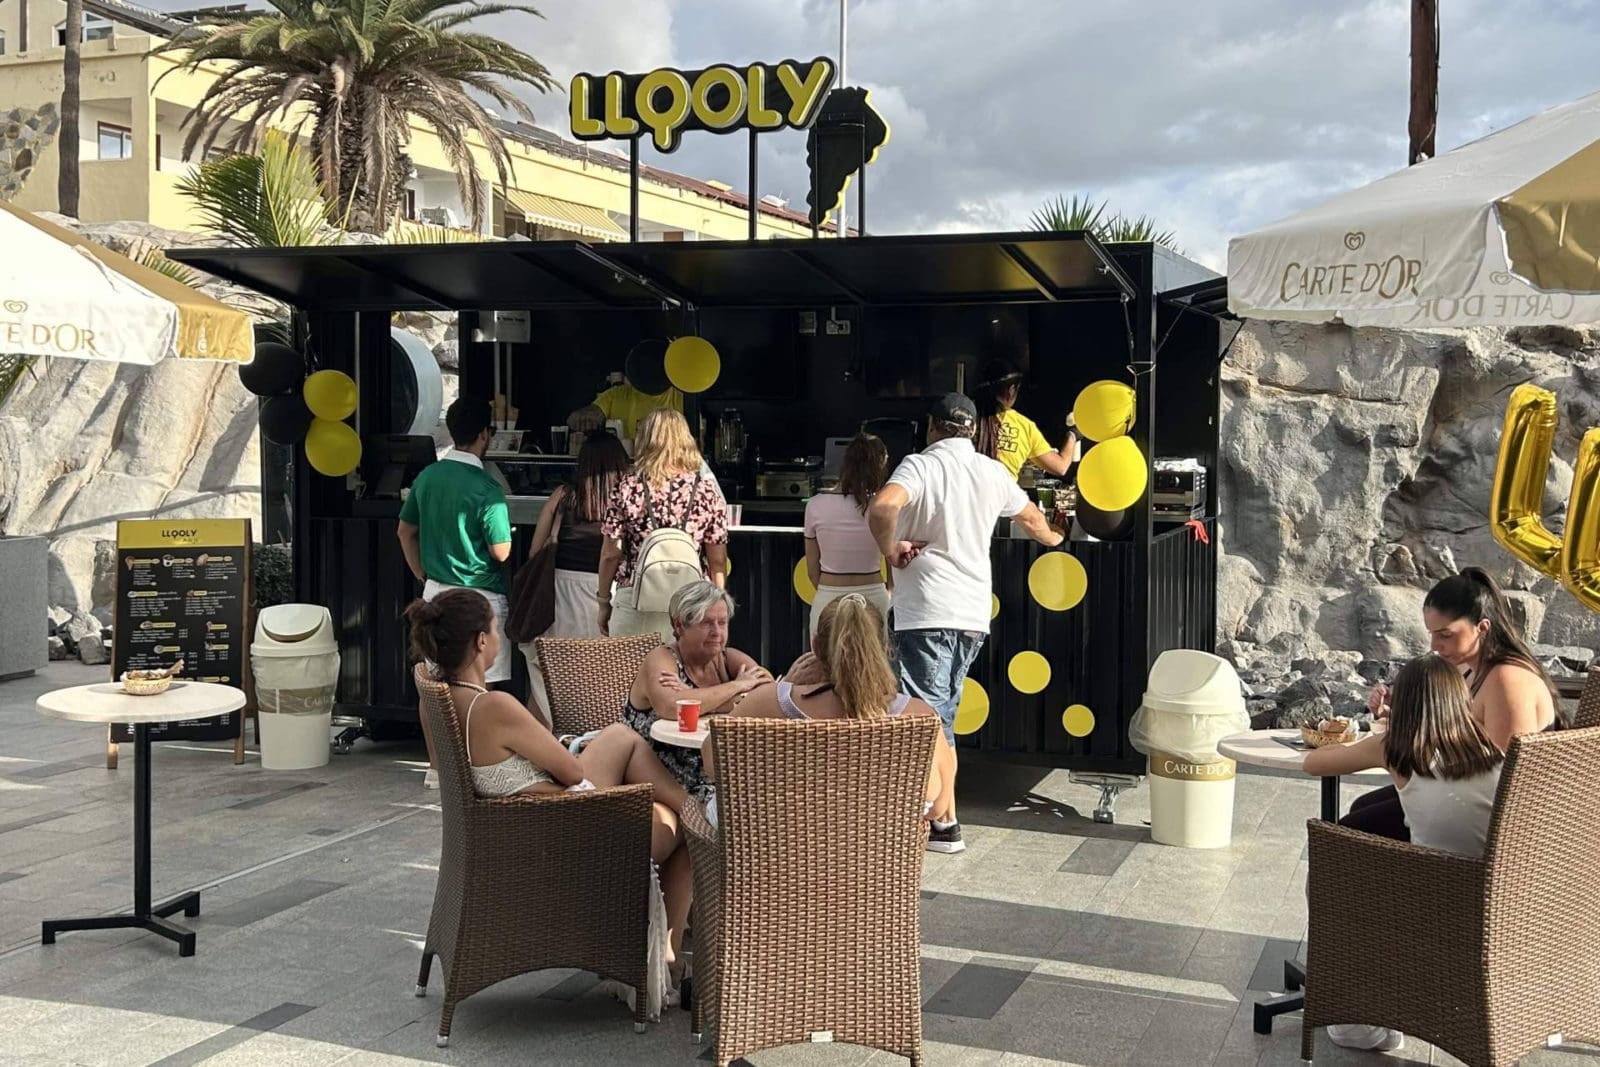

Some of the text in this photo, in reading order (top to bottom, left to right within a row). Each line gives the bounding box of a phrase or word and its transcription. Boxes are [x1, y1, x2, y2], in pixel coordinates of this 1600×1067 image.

[1280, 254, 1422, 303] CARTE D'OR
[32, 322, 106, 357] D'OR
[1164, 760, 1204, 775] CARTE
